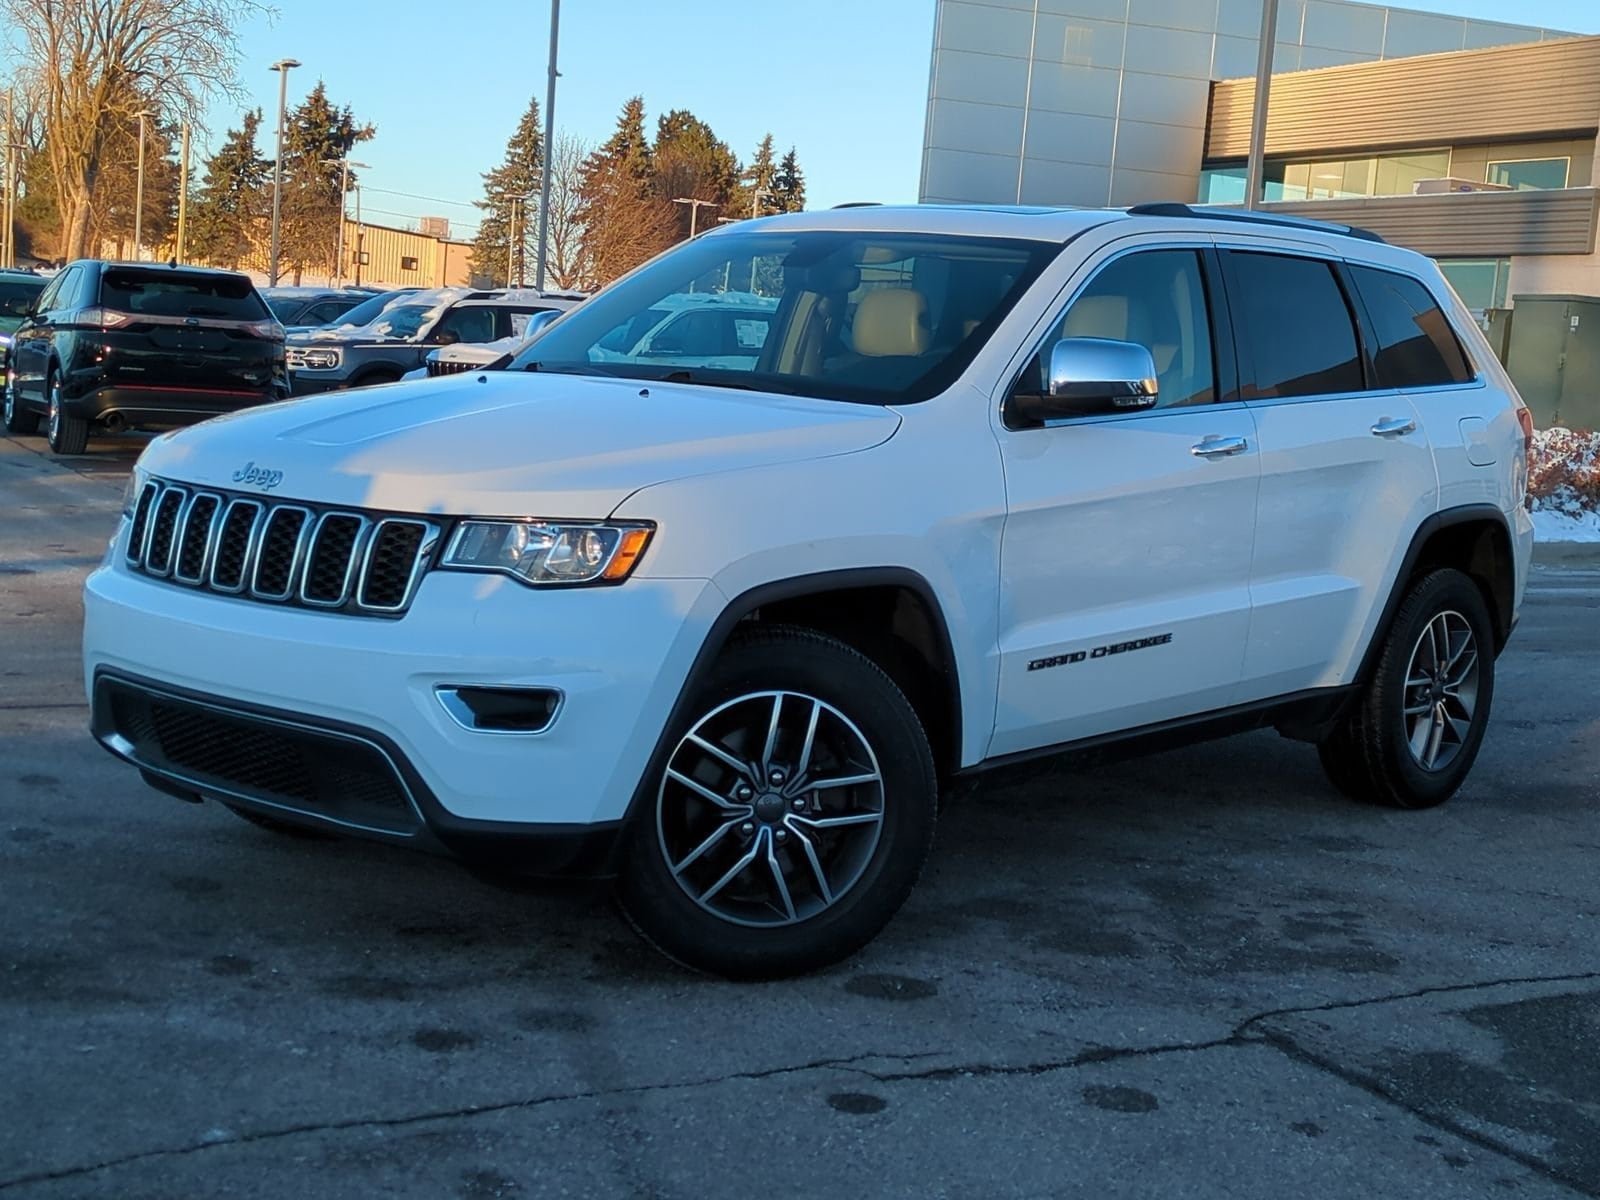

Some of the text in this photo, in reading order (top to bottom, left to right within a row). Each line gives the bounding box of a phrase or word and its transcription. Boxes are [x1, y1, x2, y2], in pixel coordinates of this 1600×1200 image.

[232, 461, 284, 492] Jeep
[1027, 632, 1173, 671] GRAND CHEROKEE
